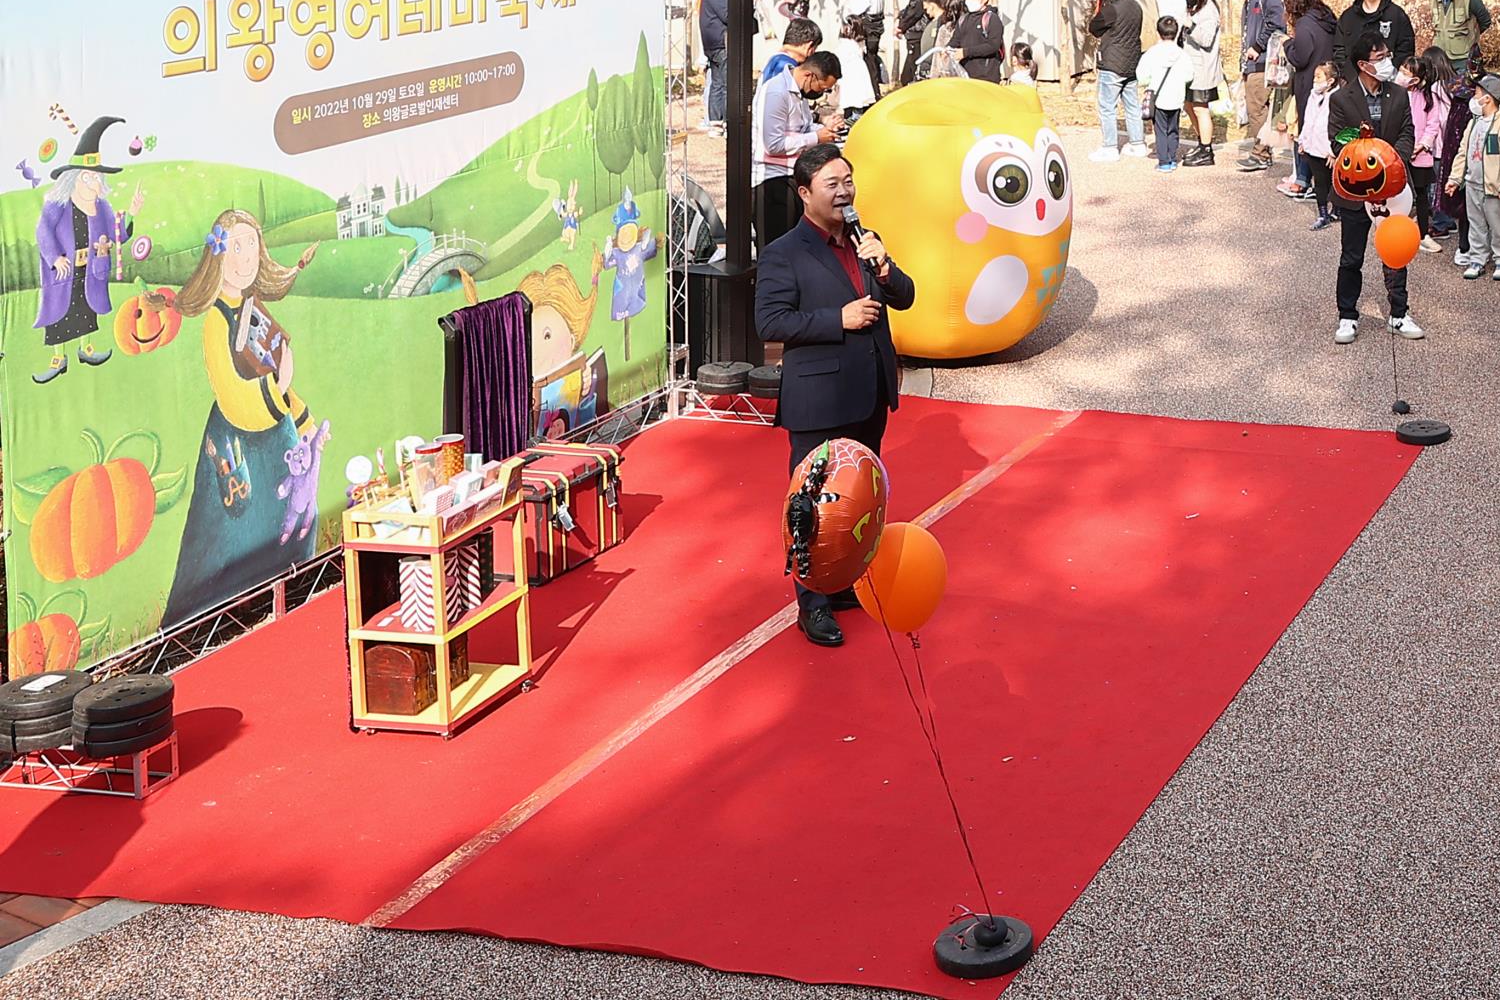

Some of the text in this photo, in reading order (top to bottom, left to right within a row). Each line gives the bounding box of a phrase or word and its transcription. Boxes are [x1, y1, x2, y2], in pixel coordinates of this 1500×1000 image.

[291, 62, 516, 125] 일시 2022년 10월 29일 토요일 운영시간 10:00~17:00
[362, 92, 460, 129] 장소 의왕글로벌인재센터
